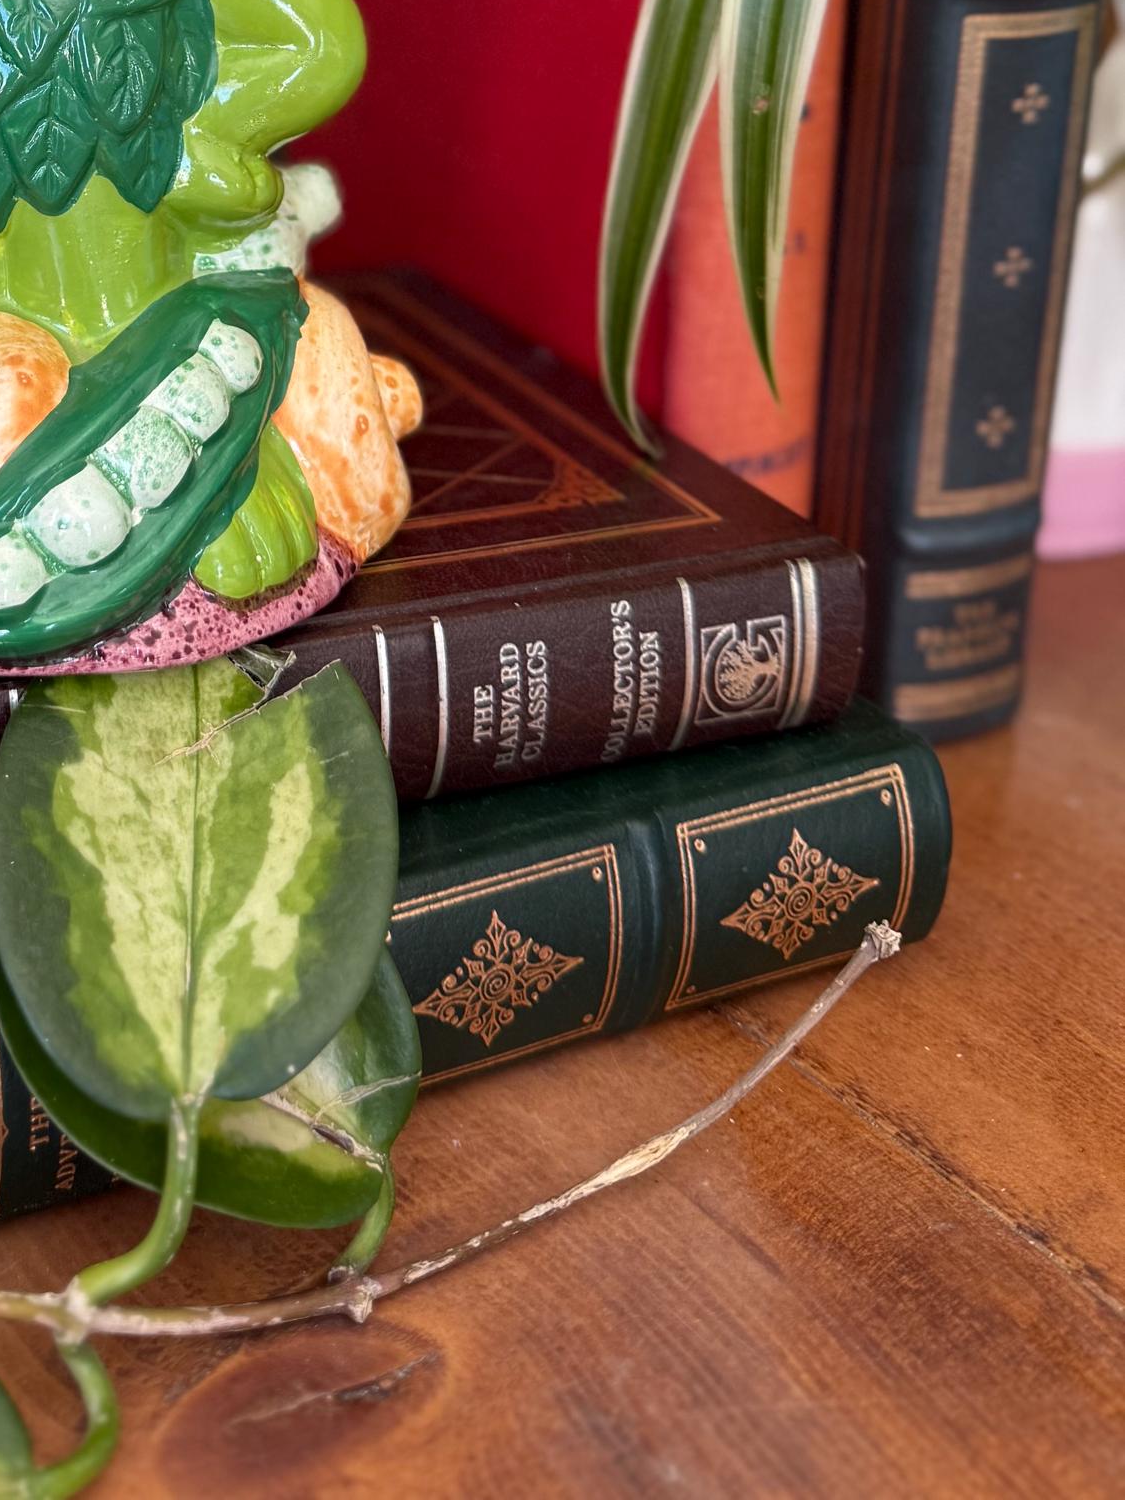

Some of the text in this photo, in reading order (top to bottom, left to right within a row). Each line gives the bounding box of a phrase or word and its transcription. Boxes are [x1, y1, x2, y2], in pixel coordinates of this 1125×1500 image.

[473, 684, 493, 744] THE
[493, 642, 520, 770] HARVARD
[523, 640, 548, 761] CLASSICS
[602, 599, 632, 762] COLLECTOR'S
[634, 630, 661, 737] EDITION
